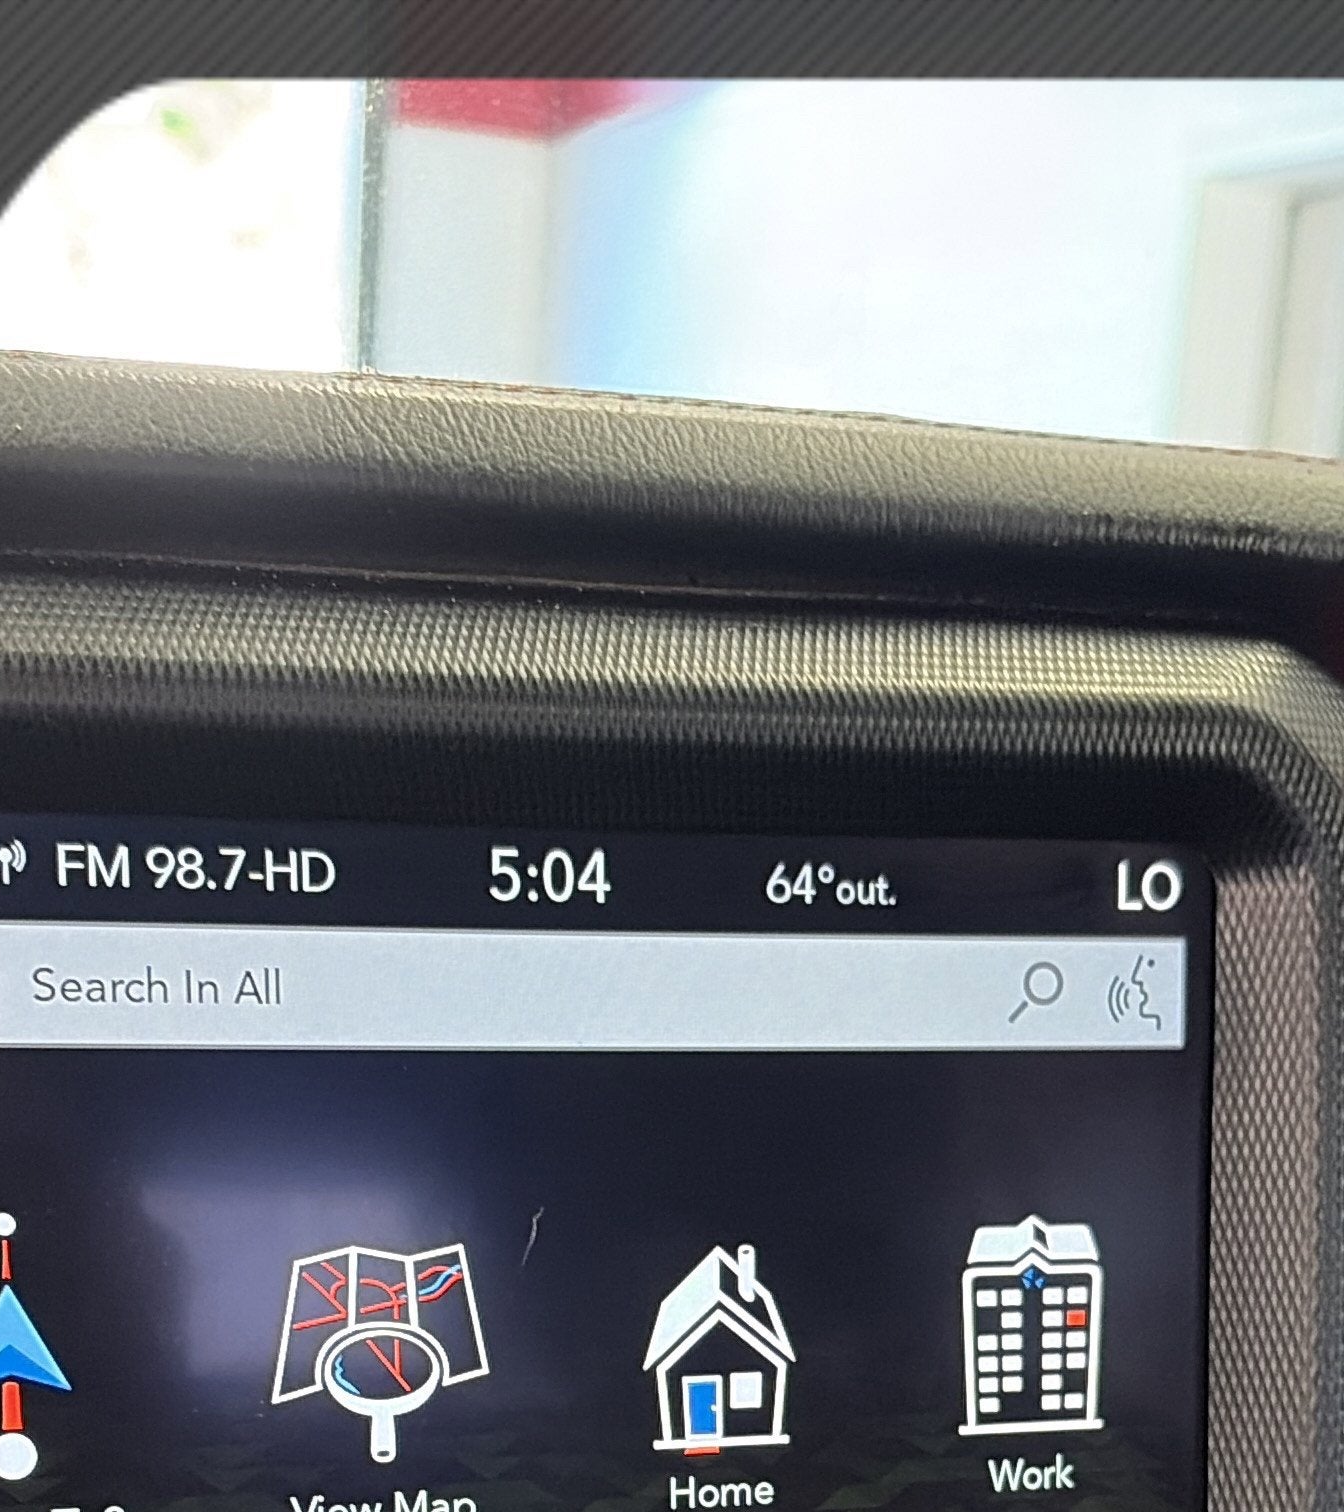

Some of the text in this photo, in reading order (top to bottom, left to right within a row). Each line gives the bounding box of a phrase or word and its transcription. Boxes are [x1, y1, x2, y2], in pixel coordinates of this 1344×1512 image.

[56, 842, 336, 893] FM 98.7-HD
[489, 846, 611, 904] 5:04
[1117, 860, 1182, 911] LO
[32, 965, 281, 1005] Search In All
[670, 1475, 775, 1510] Home
[987, 1456, 1075, 1493] Work
